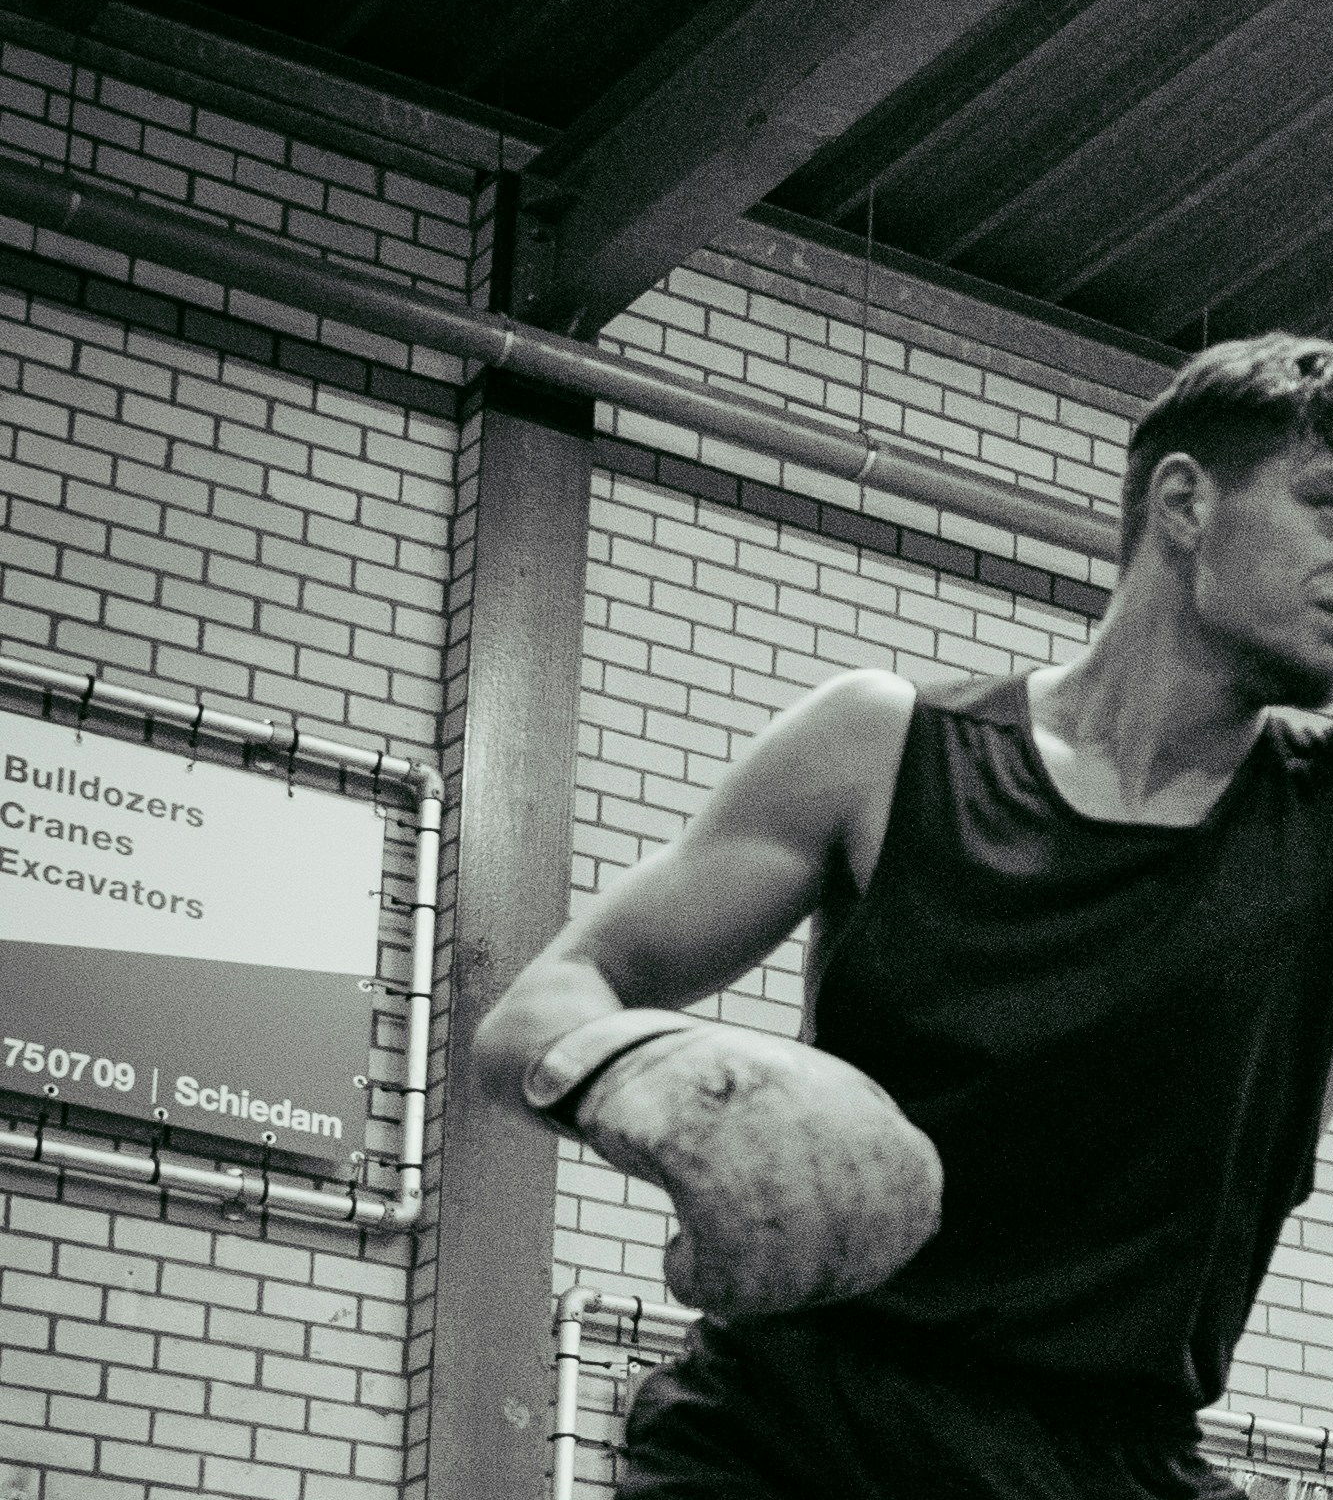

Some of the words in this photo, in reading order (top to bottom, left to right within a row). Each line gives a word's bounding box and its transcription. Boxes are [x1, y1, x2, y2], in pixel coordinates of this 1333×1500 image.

[3, 753, 206, 829] Bulldozers
[0, 802, 135, 857] Cranes
[0, 846, 205, 921] Excavators
[173, 1074, 343, 1139] Schiedam
